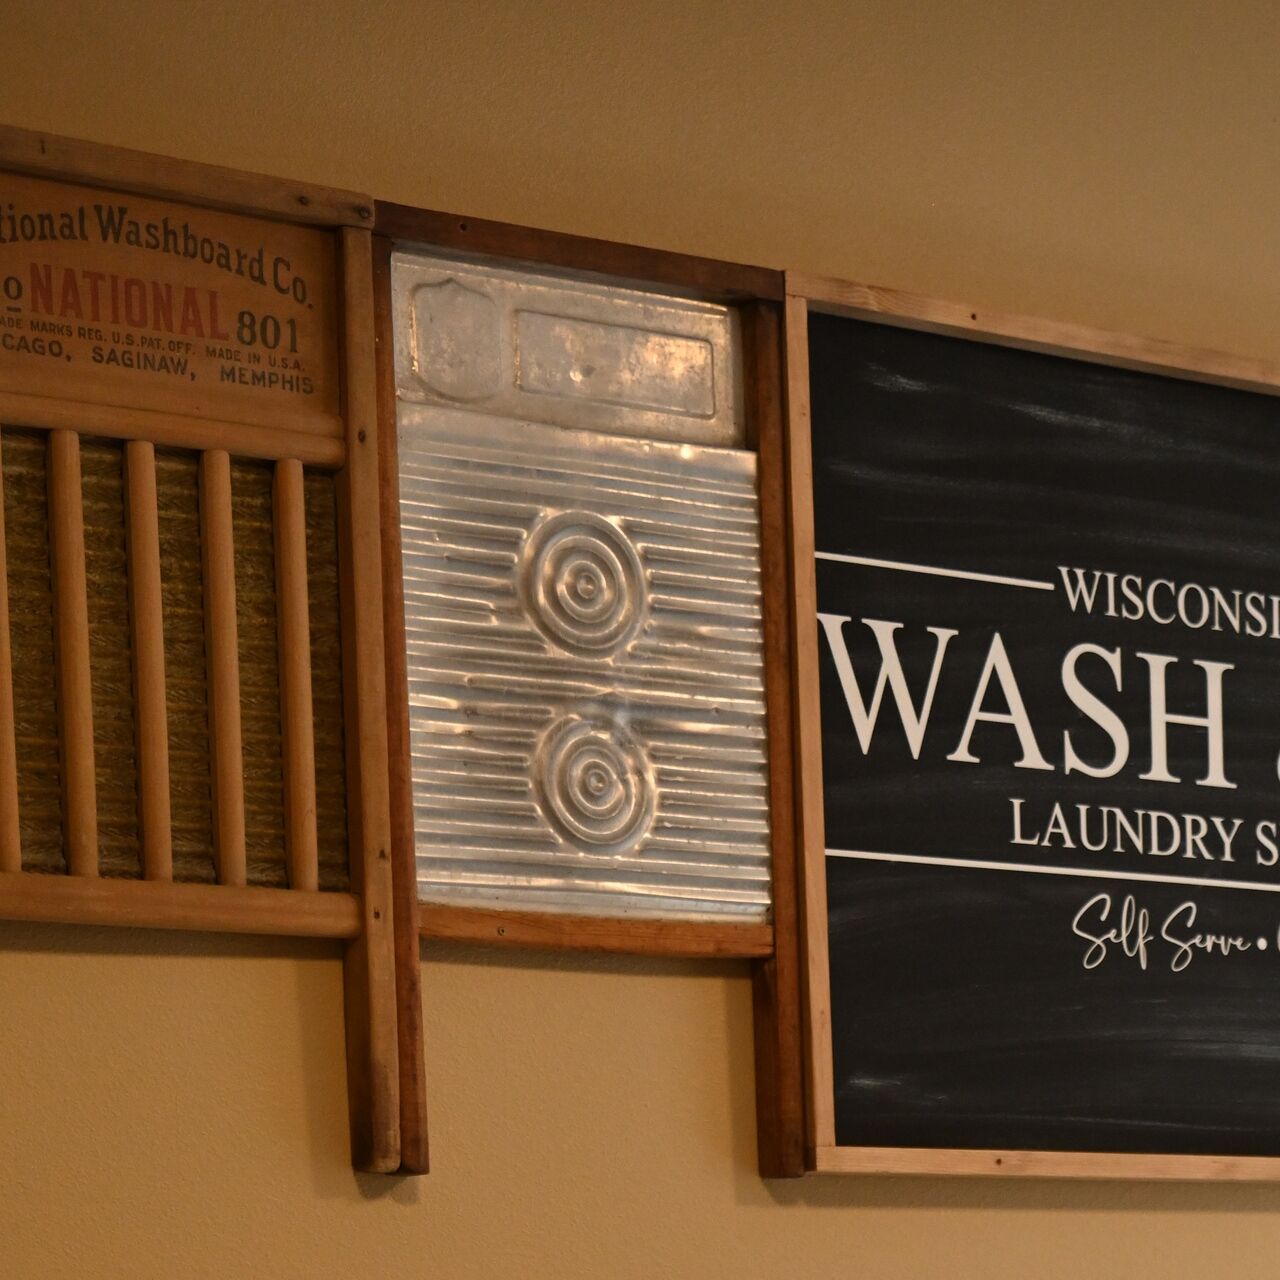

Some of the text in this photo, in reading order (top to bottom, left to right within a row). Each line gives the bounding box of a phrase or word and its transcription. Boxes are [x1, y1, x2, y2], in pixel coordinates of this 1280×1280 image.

[94, 204, 267, 287] Washboard
[273, 256, 314, 310] Co.
[29, 262, 230, 343] NATIONAL
[236, 310, 299, 354] 801
[30, 320, 74, 338] MARKS
[77, 326, 108, 343] REG.
[168, 339, 196, 356] OFF.
[206, 345, 241, 362] MADE
[248, 352, 261, 365] IN
[269, 354, 306, 373] U.S.A.
[91, 346, 197, 382] SAGINAW,
[220, 366, 315, 395] MEMPHIS
[816, 612, 1238, 789] WASH
[1009, 798, 1245, 863] LAUNDRY
[1071, 893, 1155, 970] Self
[1160, 902, 1252, 972] Serve
